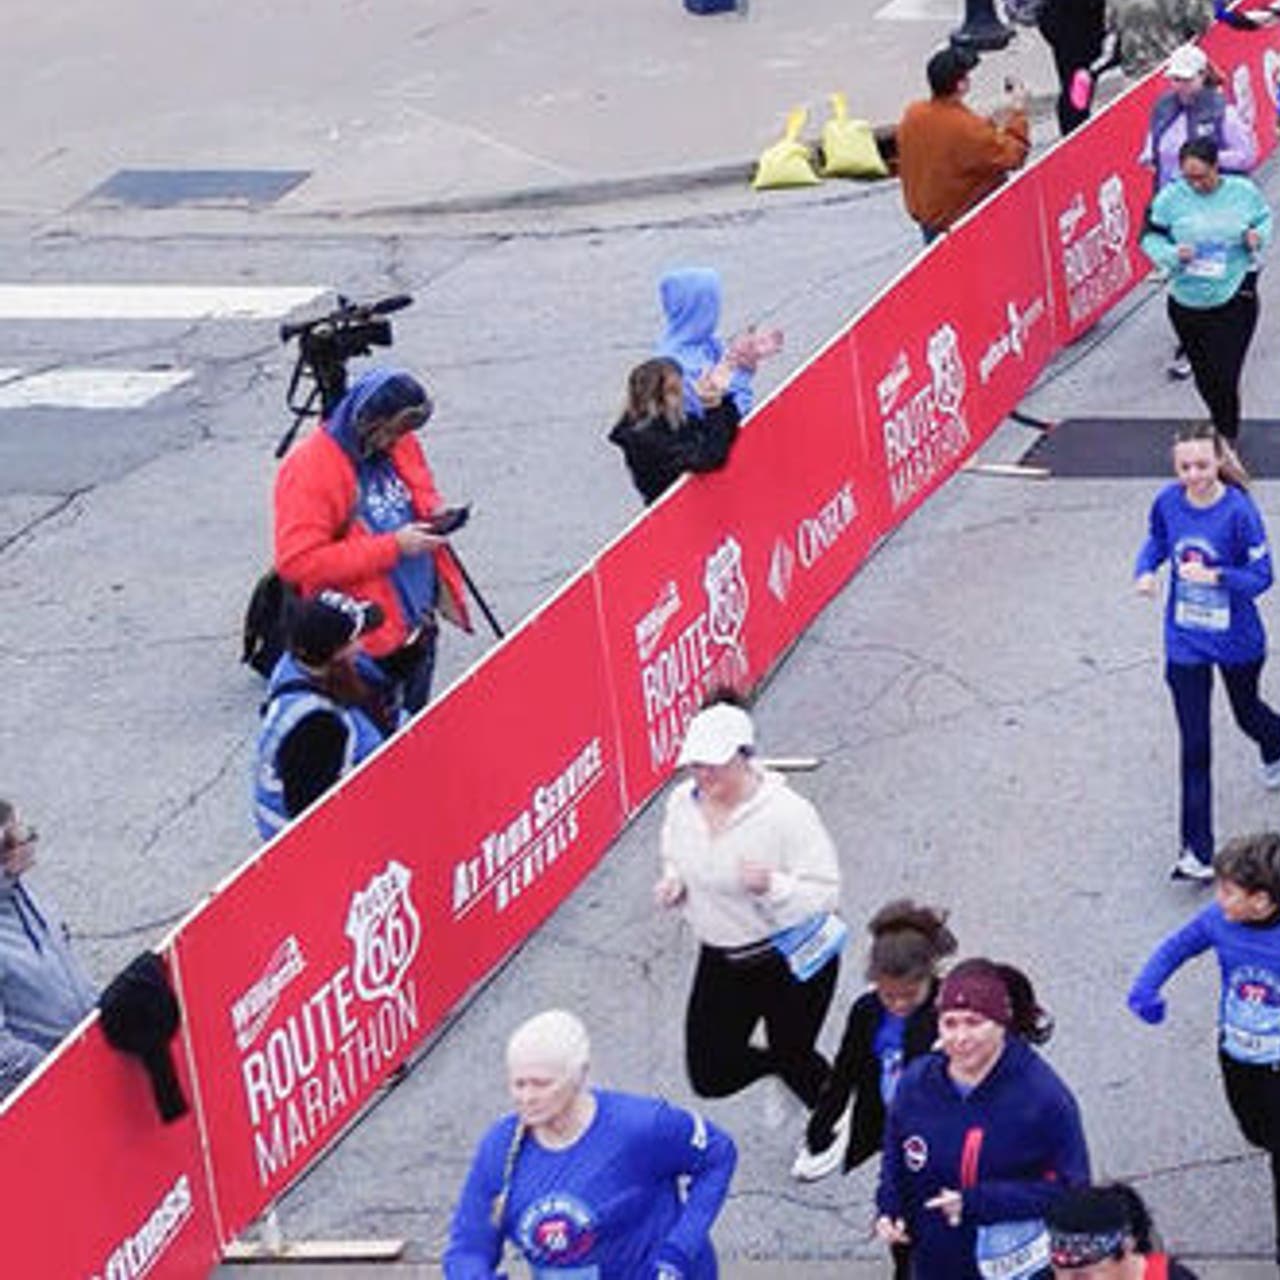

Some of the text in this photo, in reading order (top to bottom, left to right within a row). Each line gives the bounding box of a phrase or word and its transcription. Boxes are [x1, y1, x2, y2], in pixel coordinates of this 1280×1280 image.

[368, 898, 408, 984] 66
[241, 965, 358, 1124] ROUTE
[253, 981, 418, 1187] MARATHON
